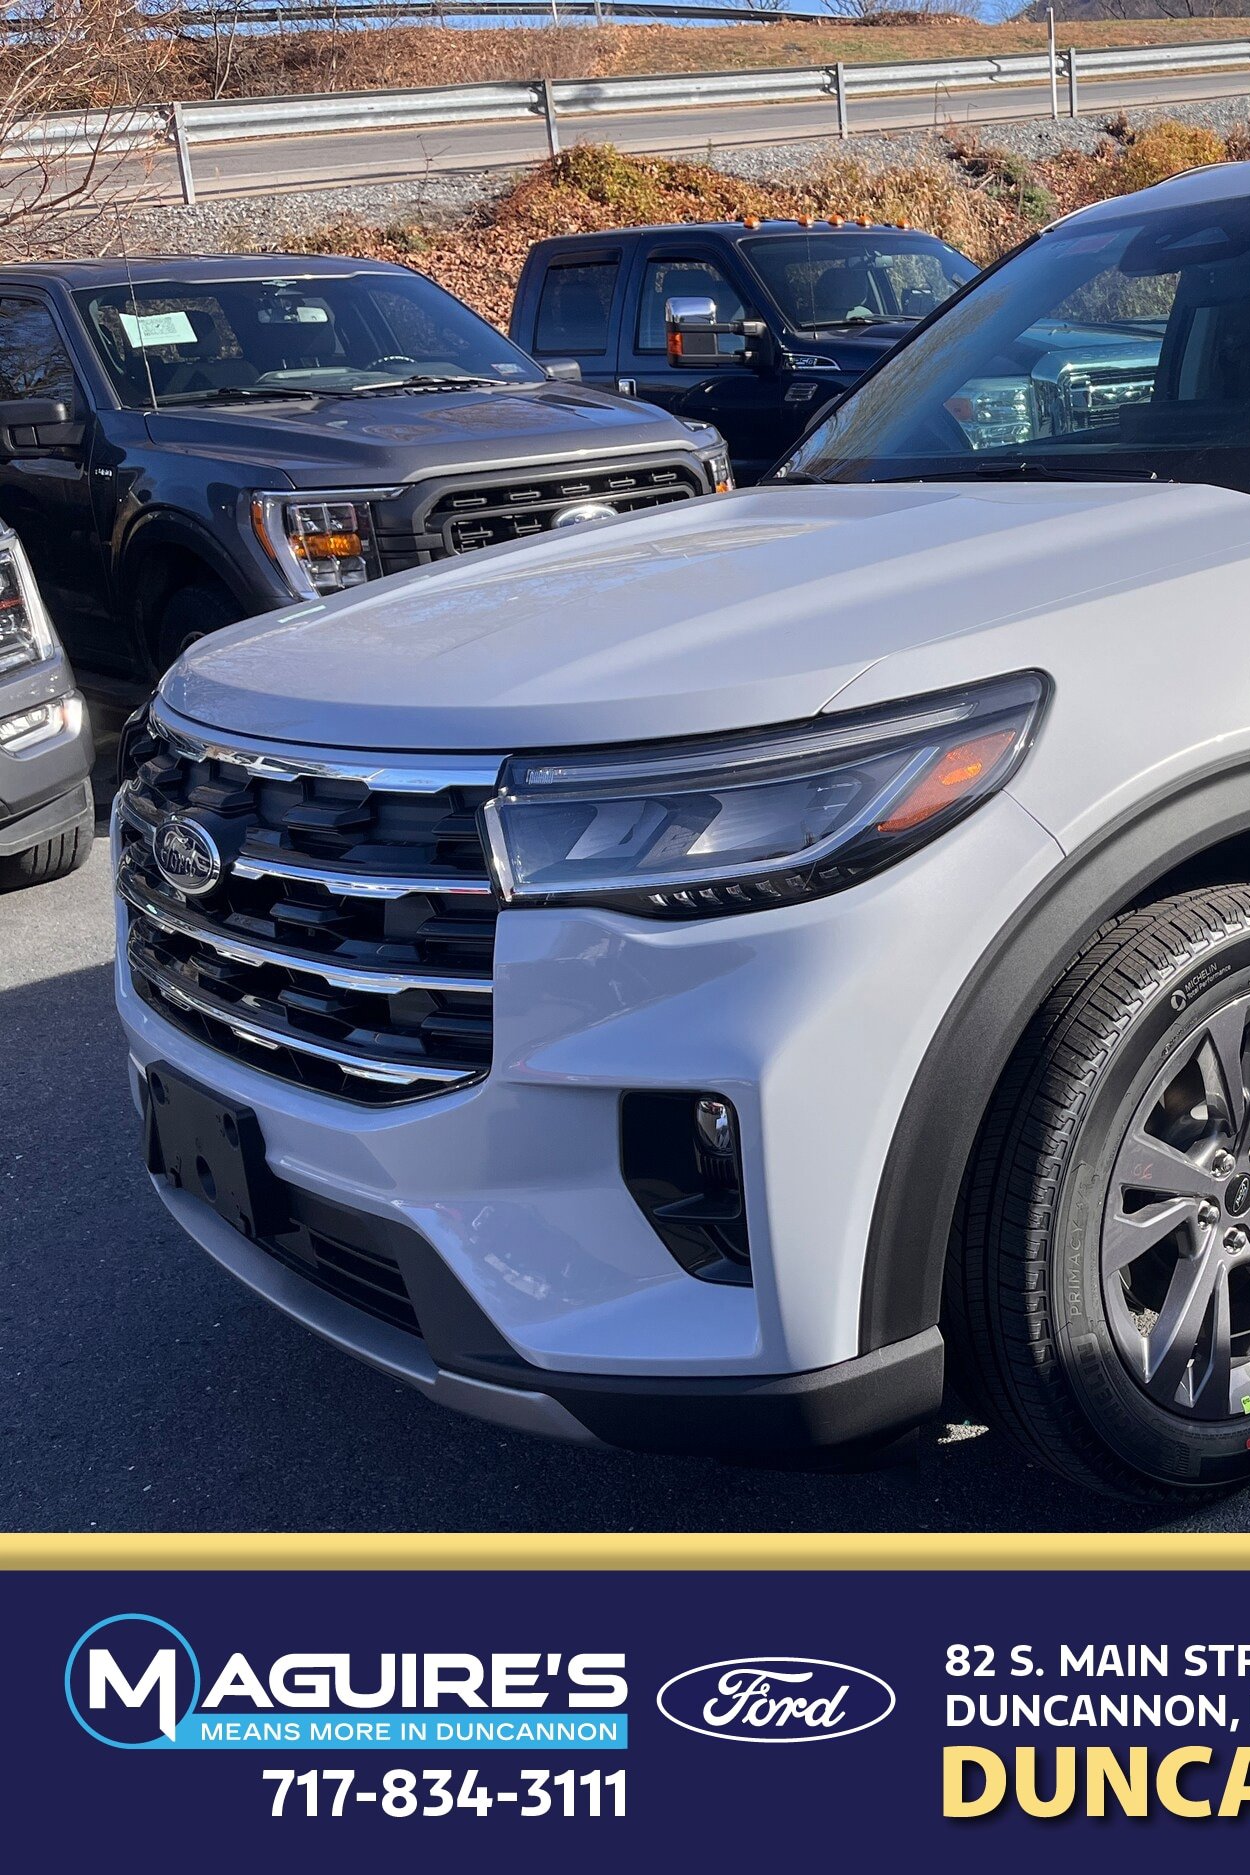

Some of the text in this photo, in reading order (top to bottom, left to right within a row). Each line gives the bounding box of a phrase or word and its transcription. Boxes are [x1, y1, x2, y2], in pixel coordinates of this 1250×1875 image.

[1184, 962, 1218, 993] MICHELIN
[1186, 983, 1200, 1000] Total
[1198, 964, 1232, 991] Performance
[1069, 1220, 1083, 1317] PRIMACY
